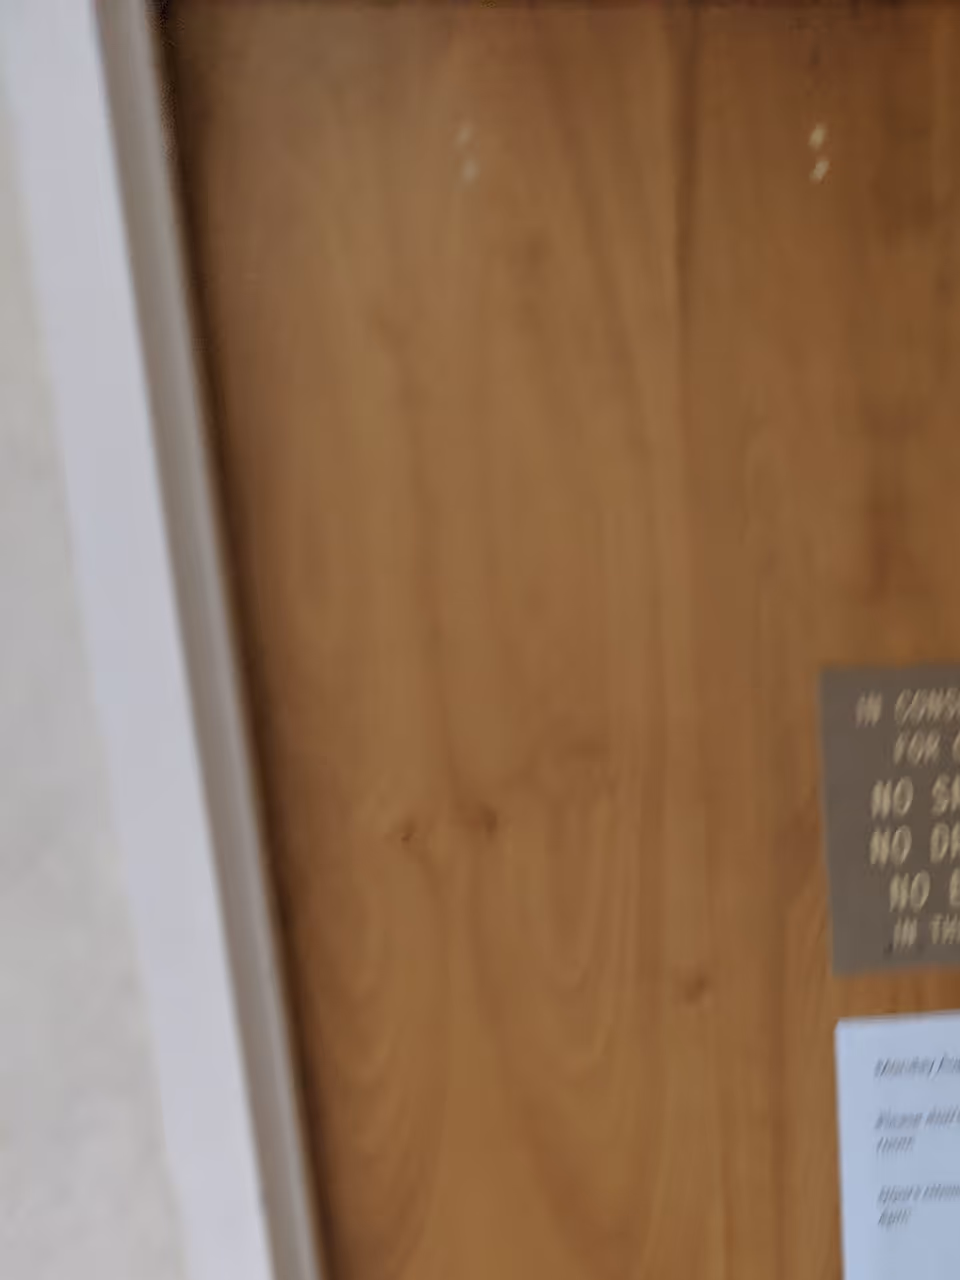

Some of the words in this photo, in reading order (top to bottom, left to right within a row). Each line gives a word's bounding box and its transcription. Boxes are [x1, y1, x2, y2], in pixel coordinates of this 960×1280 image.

[893, 729, 941, 766] FOR
[870, 776, 914, 821] NO
[869, 824, 912, 866] NO
[889, 869, 931, 914] NO
[893, 916, 917, 951] IN
